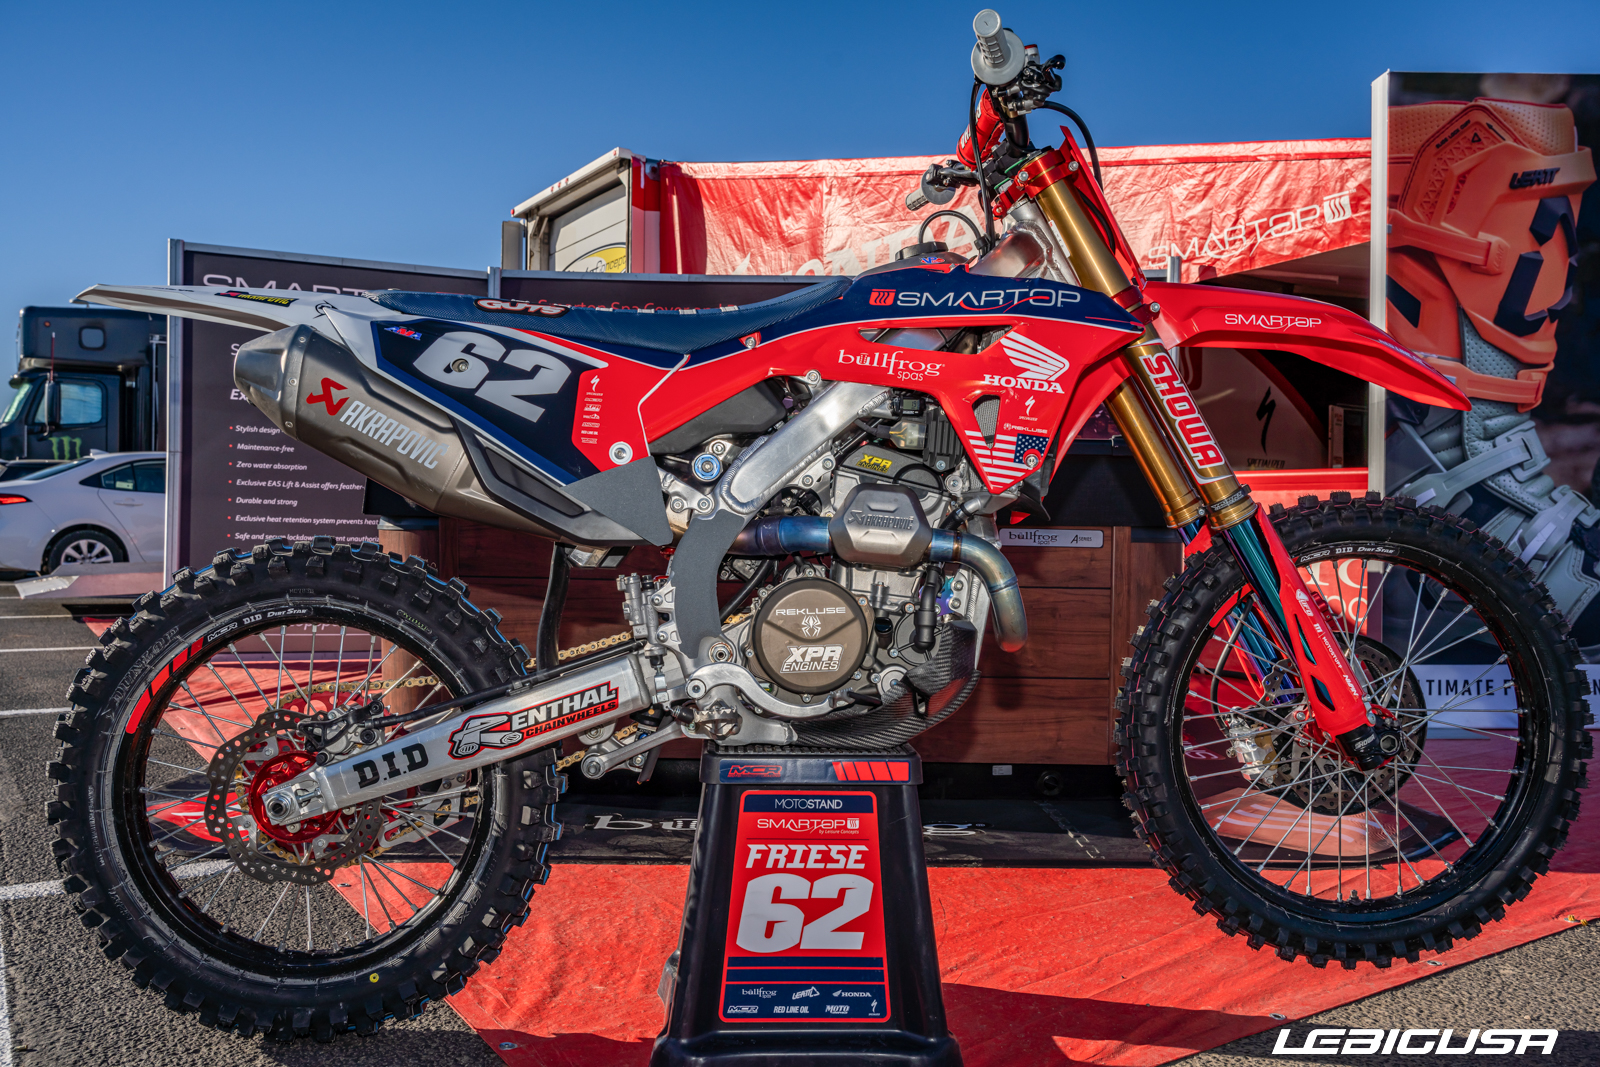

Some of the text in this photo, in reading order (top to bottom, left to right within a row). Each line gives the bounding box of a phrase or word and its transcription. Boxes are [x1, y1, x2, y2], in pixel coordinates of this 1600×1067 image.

[1509, 167, 1561, 190] LEATT
[1149, 204, 1320, 267] SMARTOP
[897, 288, 1081, 312] SMARTOP
[478, 300, 566, 315] GUTS
[1225, 314, 1322, 331] SMARTOP
[838, 350, 942, 377] bullfrog
[412, 331, 571, 423] 62
[897, 371, 924, 381] spas
[983, 374, 1065, 394] HONDA
[1139, 352, 1225, 469] SHOWA
[235, 424, 280, 435] Stylish design
[237, 443, 295, 453] Maintenance-free
[273, 463, 308, 471] absorption
[236, 479, 267, 487] Exclusive
[282, 481, 294, 489] Lift
[321, 483, 339, 491] offers
[277, 499, 298, 507] strong
[235, 514, 266, 523] Exclusive
[266, 515, 282, 523] heat
[313, 518, 335, 526] system
[234, 532, 250, 541] Safe
[1009, 530, 1058, 543] bullfrog
[775, 607, 846, 616] REKLUSE
[243, 614, 262, 625] DID
[788, 645, 843, 662] XPR
[1322, 636, 1343, 669] MOTOSTUFF
[782, 660, 840, 673] ENGINES
[1426, 679, 1494, 696] TIMATE
[450, 685, 618, 757] RENTHAL
[526, 701, 617, 738] CHAINWHEELS
[352, 743, 430, 788] D.I.D
[729, 765, 782, 775] MCR
[775, 799, 843, 809] MOTOSTAND
[757, 818, 846, 832] SMARTOP
[745, 844, 869, 869] FRIESE
[736, 873, 874, 953] 62
[742, 987, 777, 997] bullfrog
[727, 1005, 758, 1014] MCR
